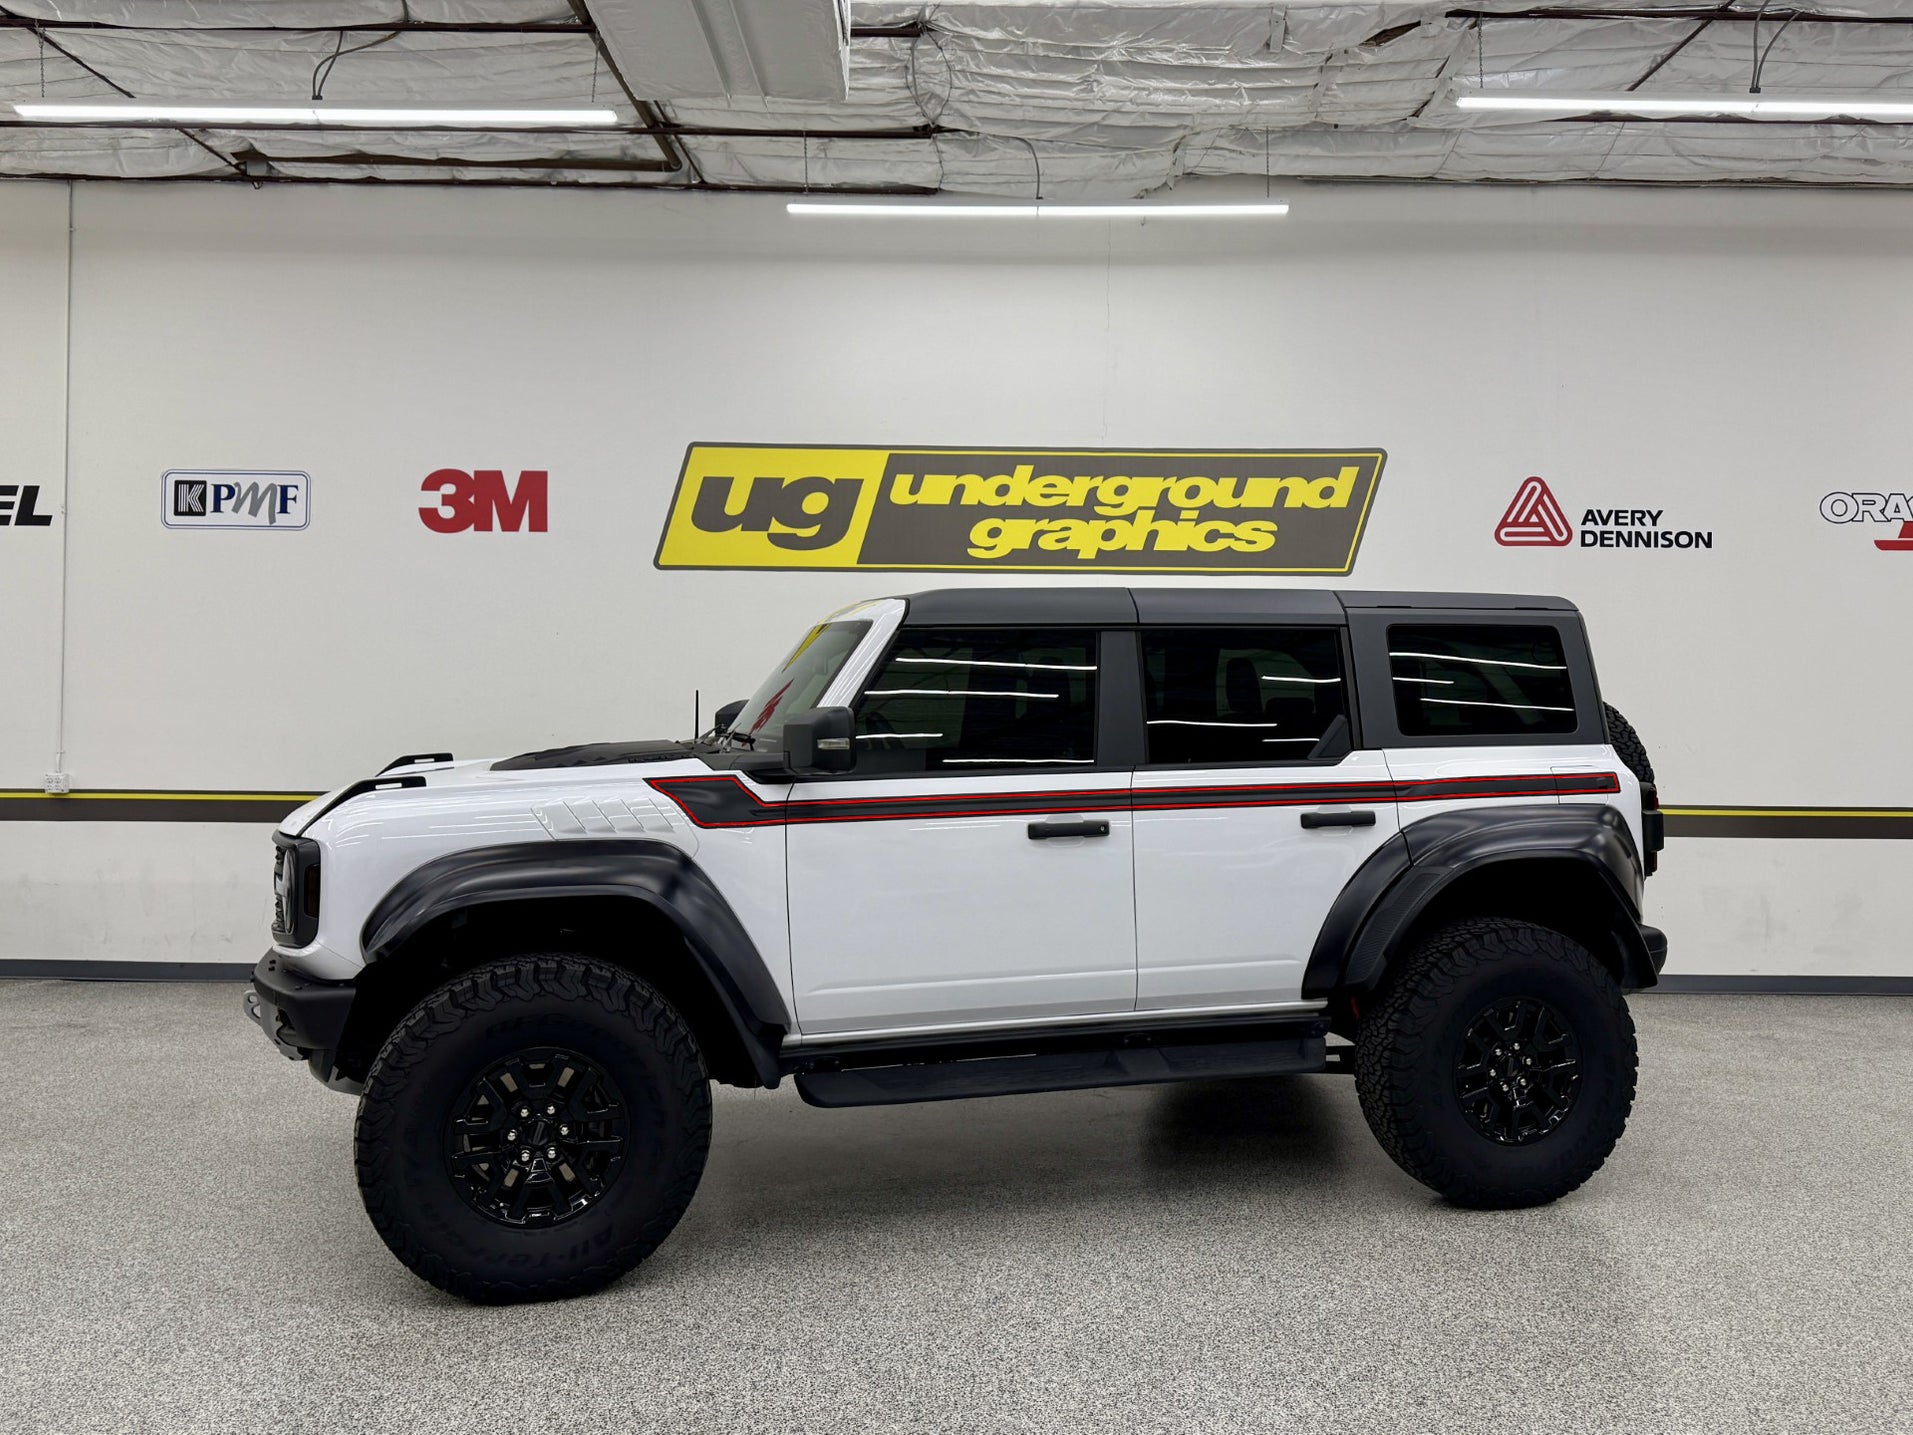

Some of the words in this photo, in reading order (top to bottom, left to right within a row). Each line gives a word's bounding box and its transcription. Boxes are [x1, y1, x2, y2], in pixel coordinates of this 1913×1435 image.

[418, 468, 548, 534] 3M
[690, 475, 865, 551] ug
[889, 464, 1359, 516] underground
[1819, 491, 1913, 524] ORA
[967, 509, 1278, 559] graphics
[1580, 508, 1664, 527] AVERY
[1580, 529, 1713, 549] DENNISON
